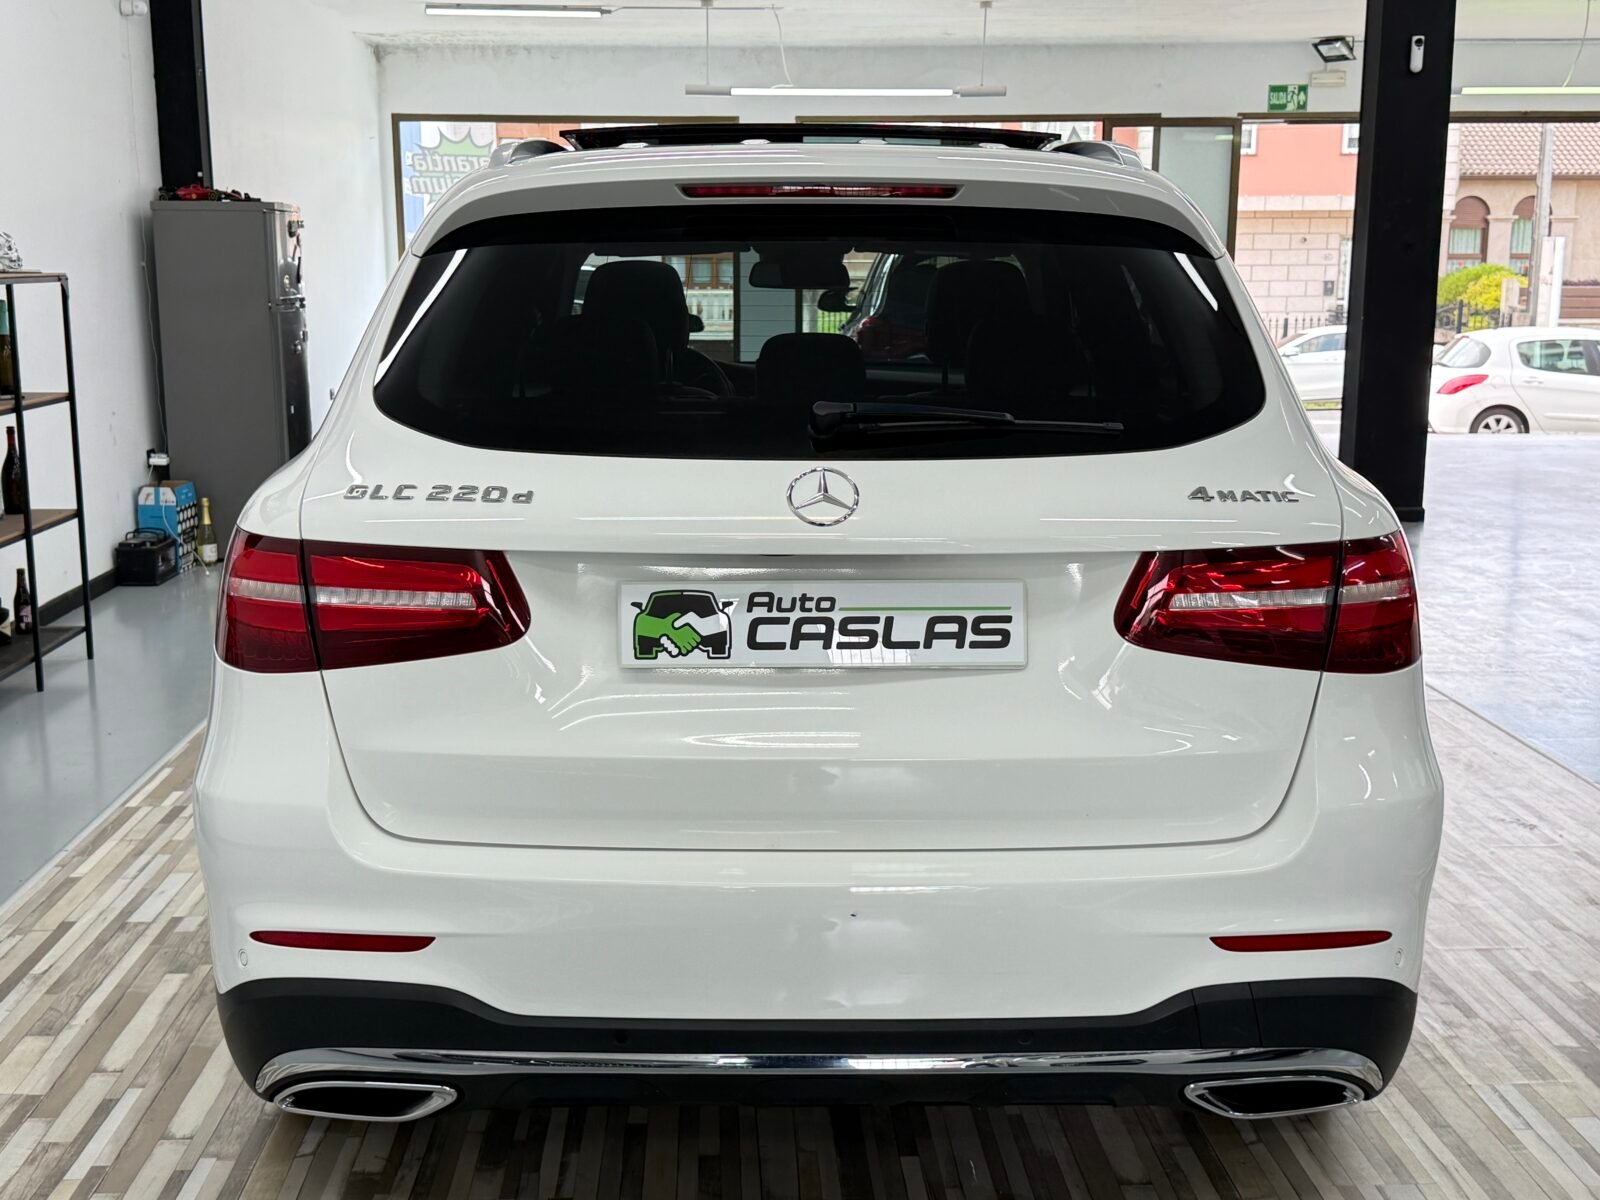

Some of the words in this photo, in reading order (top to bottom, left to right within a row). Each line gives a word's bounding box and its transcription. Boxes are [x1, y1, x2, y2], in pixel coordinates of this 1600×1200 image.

[343, 484, 418, 500] GLC
[425, 484, 534, 504] 220d
[746, 591, 836, 613] Auto
[746, 615, 1012, 650] CASLAS
